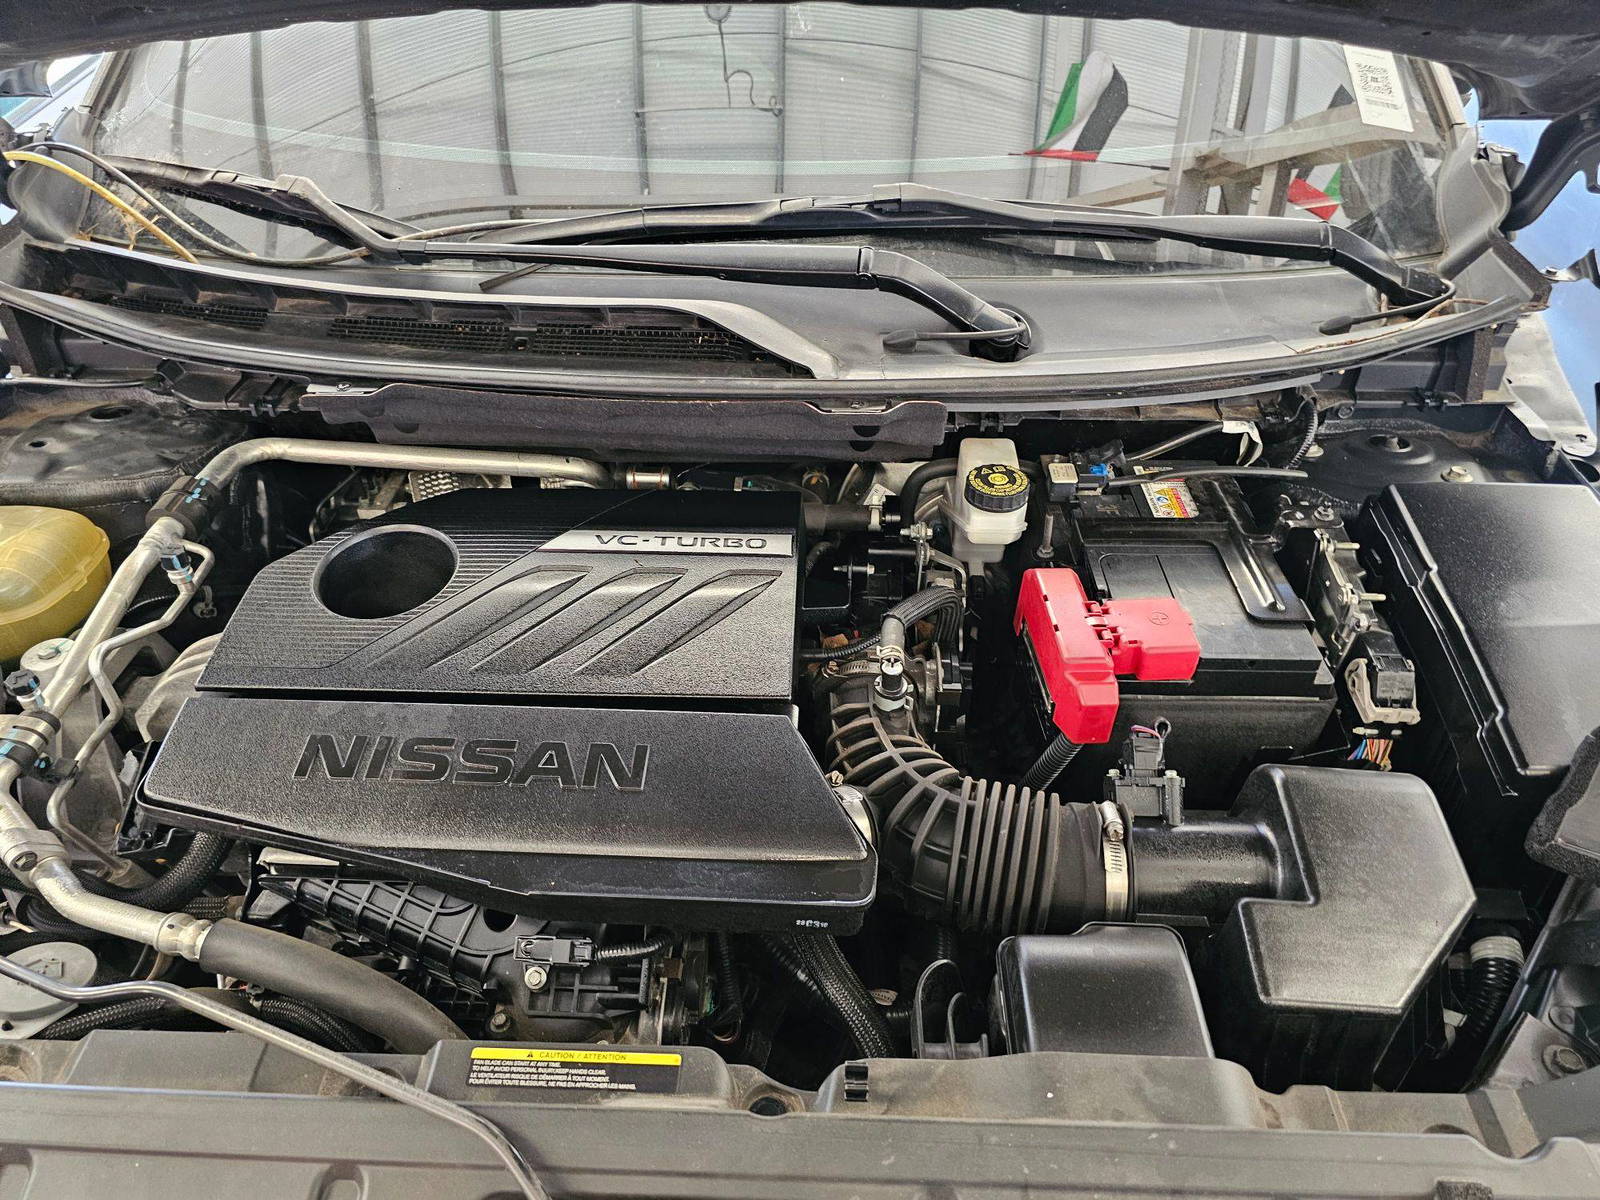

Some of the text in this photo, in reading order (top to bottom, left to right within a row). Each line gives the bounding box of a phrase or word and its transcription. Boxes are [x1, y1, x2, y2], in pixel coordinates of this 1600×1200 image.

[595, 534, 767, 549] VC-TURBO
[292, 734, 649, 791] NISSAN
[540, 1051, 575, 1059] CAUTION
[583, 1053, 627, 1061] ATTENTION
